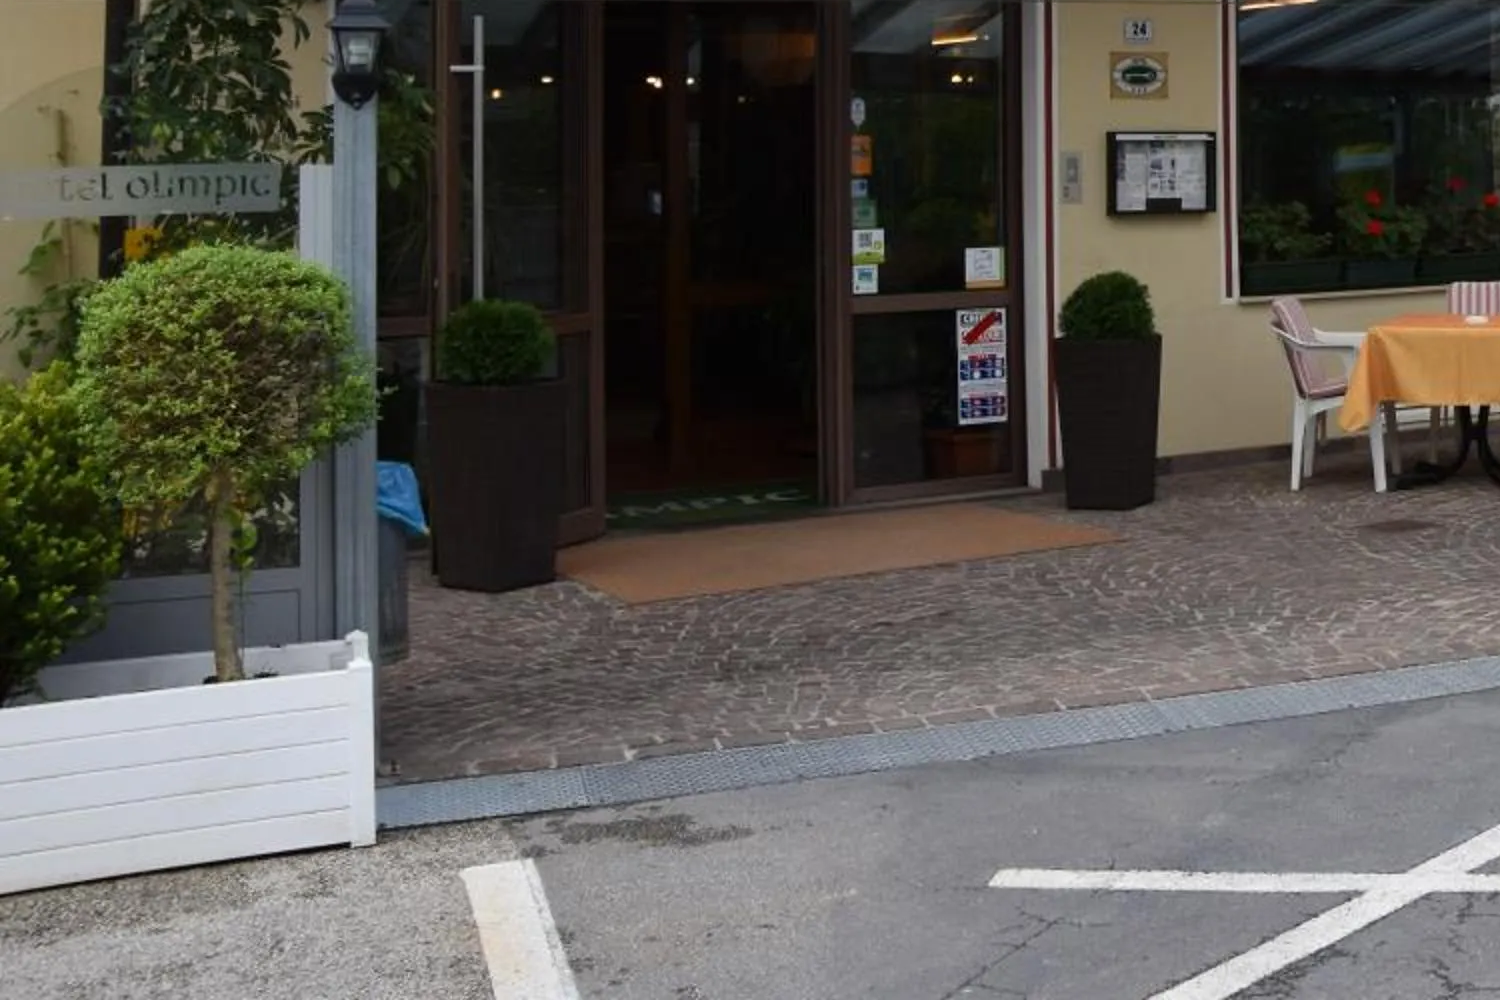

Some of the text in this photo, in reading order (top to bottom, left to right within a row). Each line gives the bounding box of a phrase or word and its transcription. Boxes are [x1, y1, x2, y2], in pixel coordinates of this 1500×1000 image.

[54, 170, 271, 205] tel olimpic
[604, 489, 810, 518] MPIC
